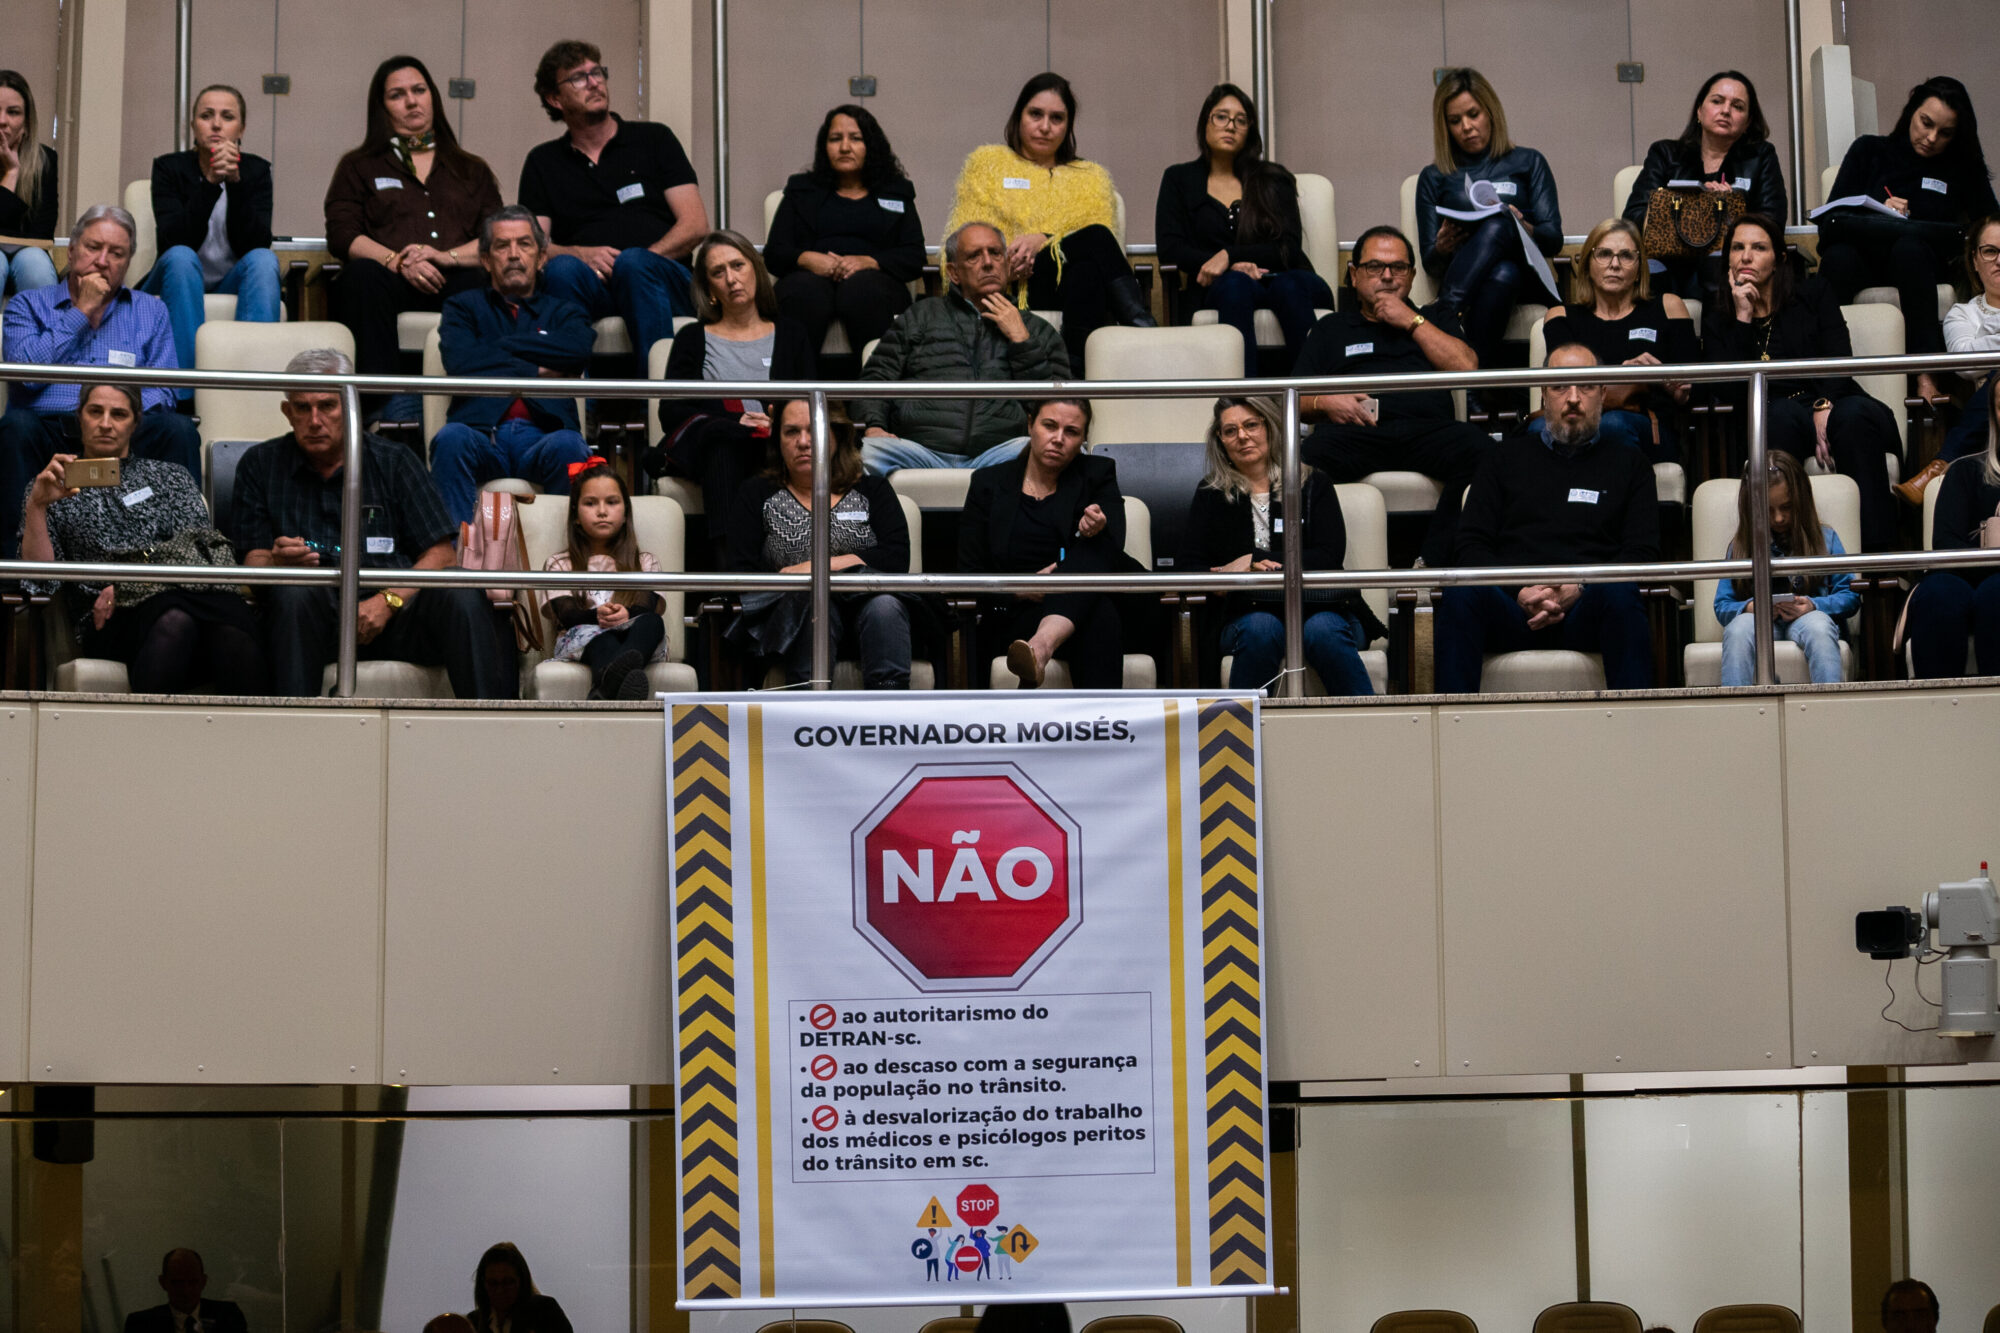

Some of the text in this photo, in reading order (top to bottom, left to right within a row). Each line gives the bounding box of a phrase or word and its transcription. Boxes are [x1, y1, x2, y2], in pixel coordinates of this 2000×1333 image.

[793, 716, 1137, 748] GOVERNADOR MOISÉS,
[882, 829, 1054, 904] NÃO
[842, 1003, 1049, 1024] ao autoritarismo do
[800, 1031, 922, 1047] DETRAN-sc.
[843, 1055, 1138, 1075] ao descaso com a segurança
[800, 1076, 1066, 1102] da população no trânsito.
[844, 1102, 1143, 1127] à desvalorização do trabalho
[801, 1124, 1146, 1150] dos médicos e psicólogos peritos
[802, 1153, 989, 1172] do trânsito em sc.
[961, 1199, 995, 1212] STOP
